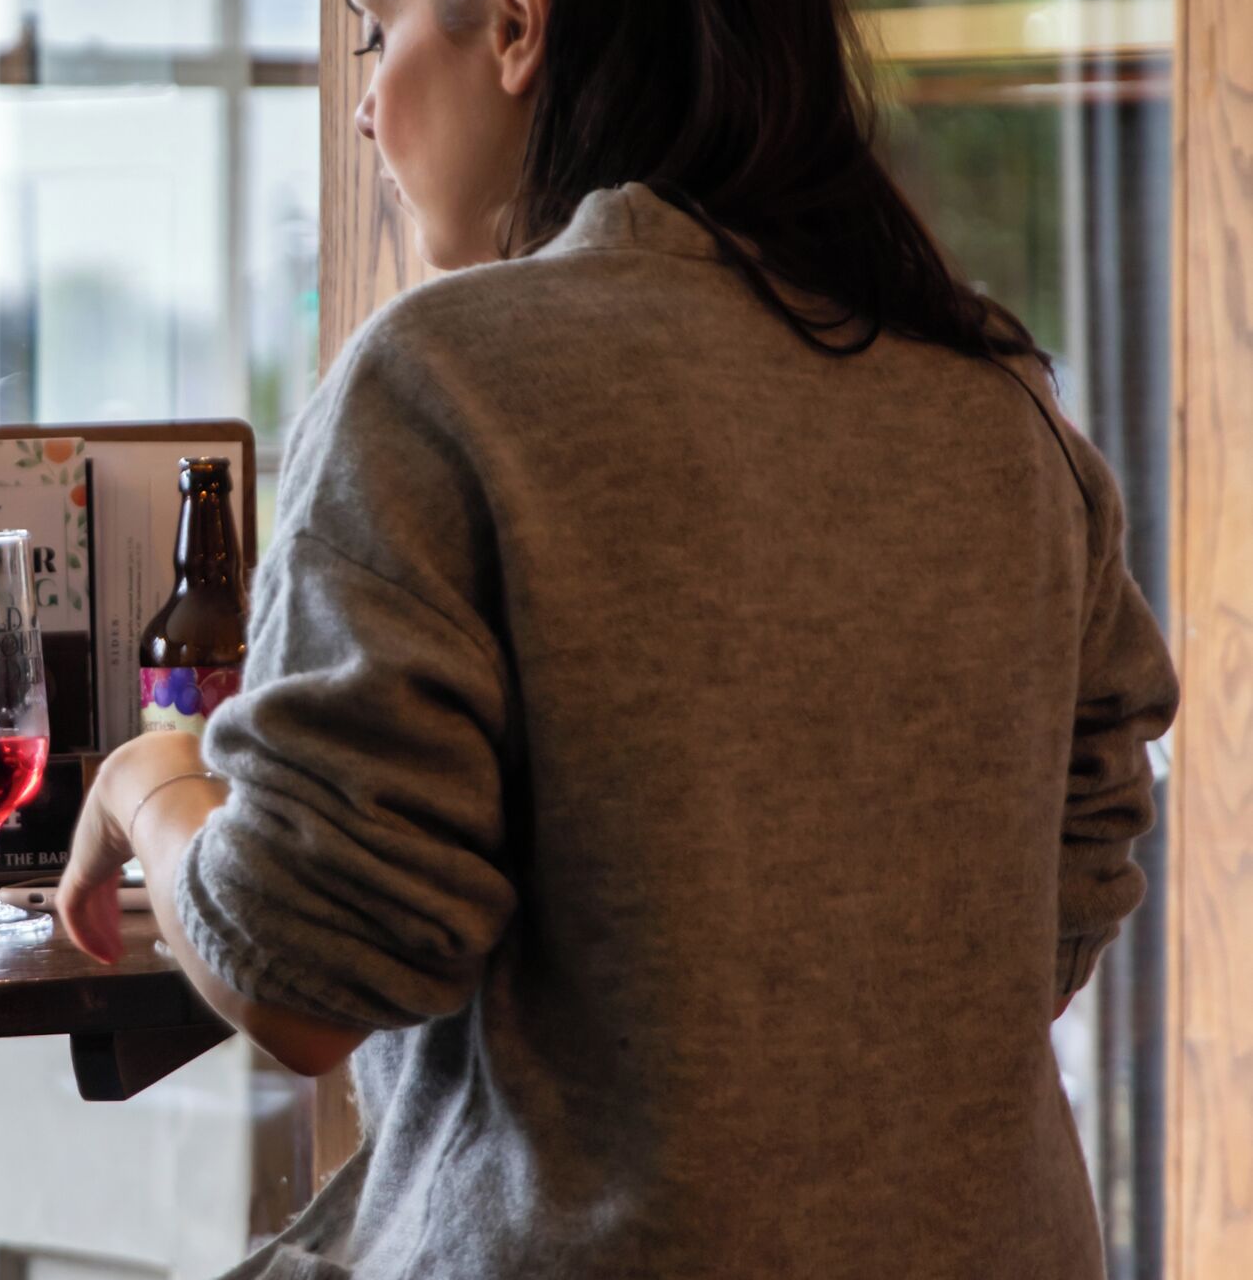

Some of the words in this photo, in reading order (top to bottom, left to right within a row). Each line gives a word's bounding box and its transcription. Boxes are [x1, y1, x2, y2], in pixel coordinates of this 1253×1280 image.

[110, 618, 120, 666] SIDES
[4, 852, 38, 866] THE
[39, 850, 69, 865] BAR
